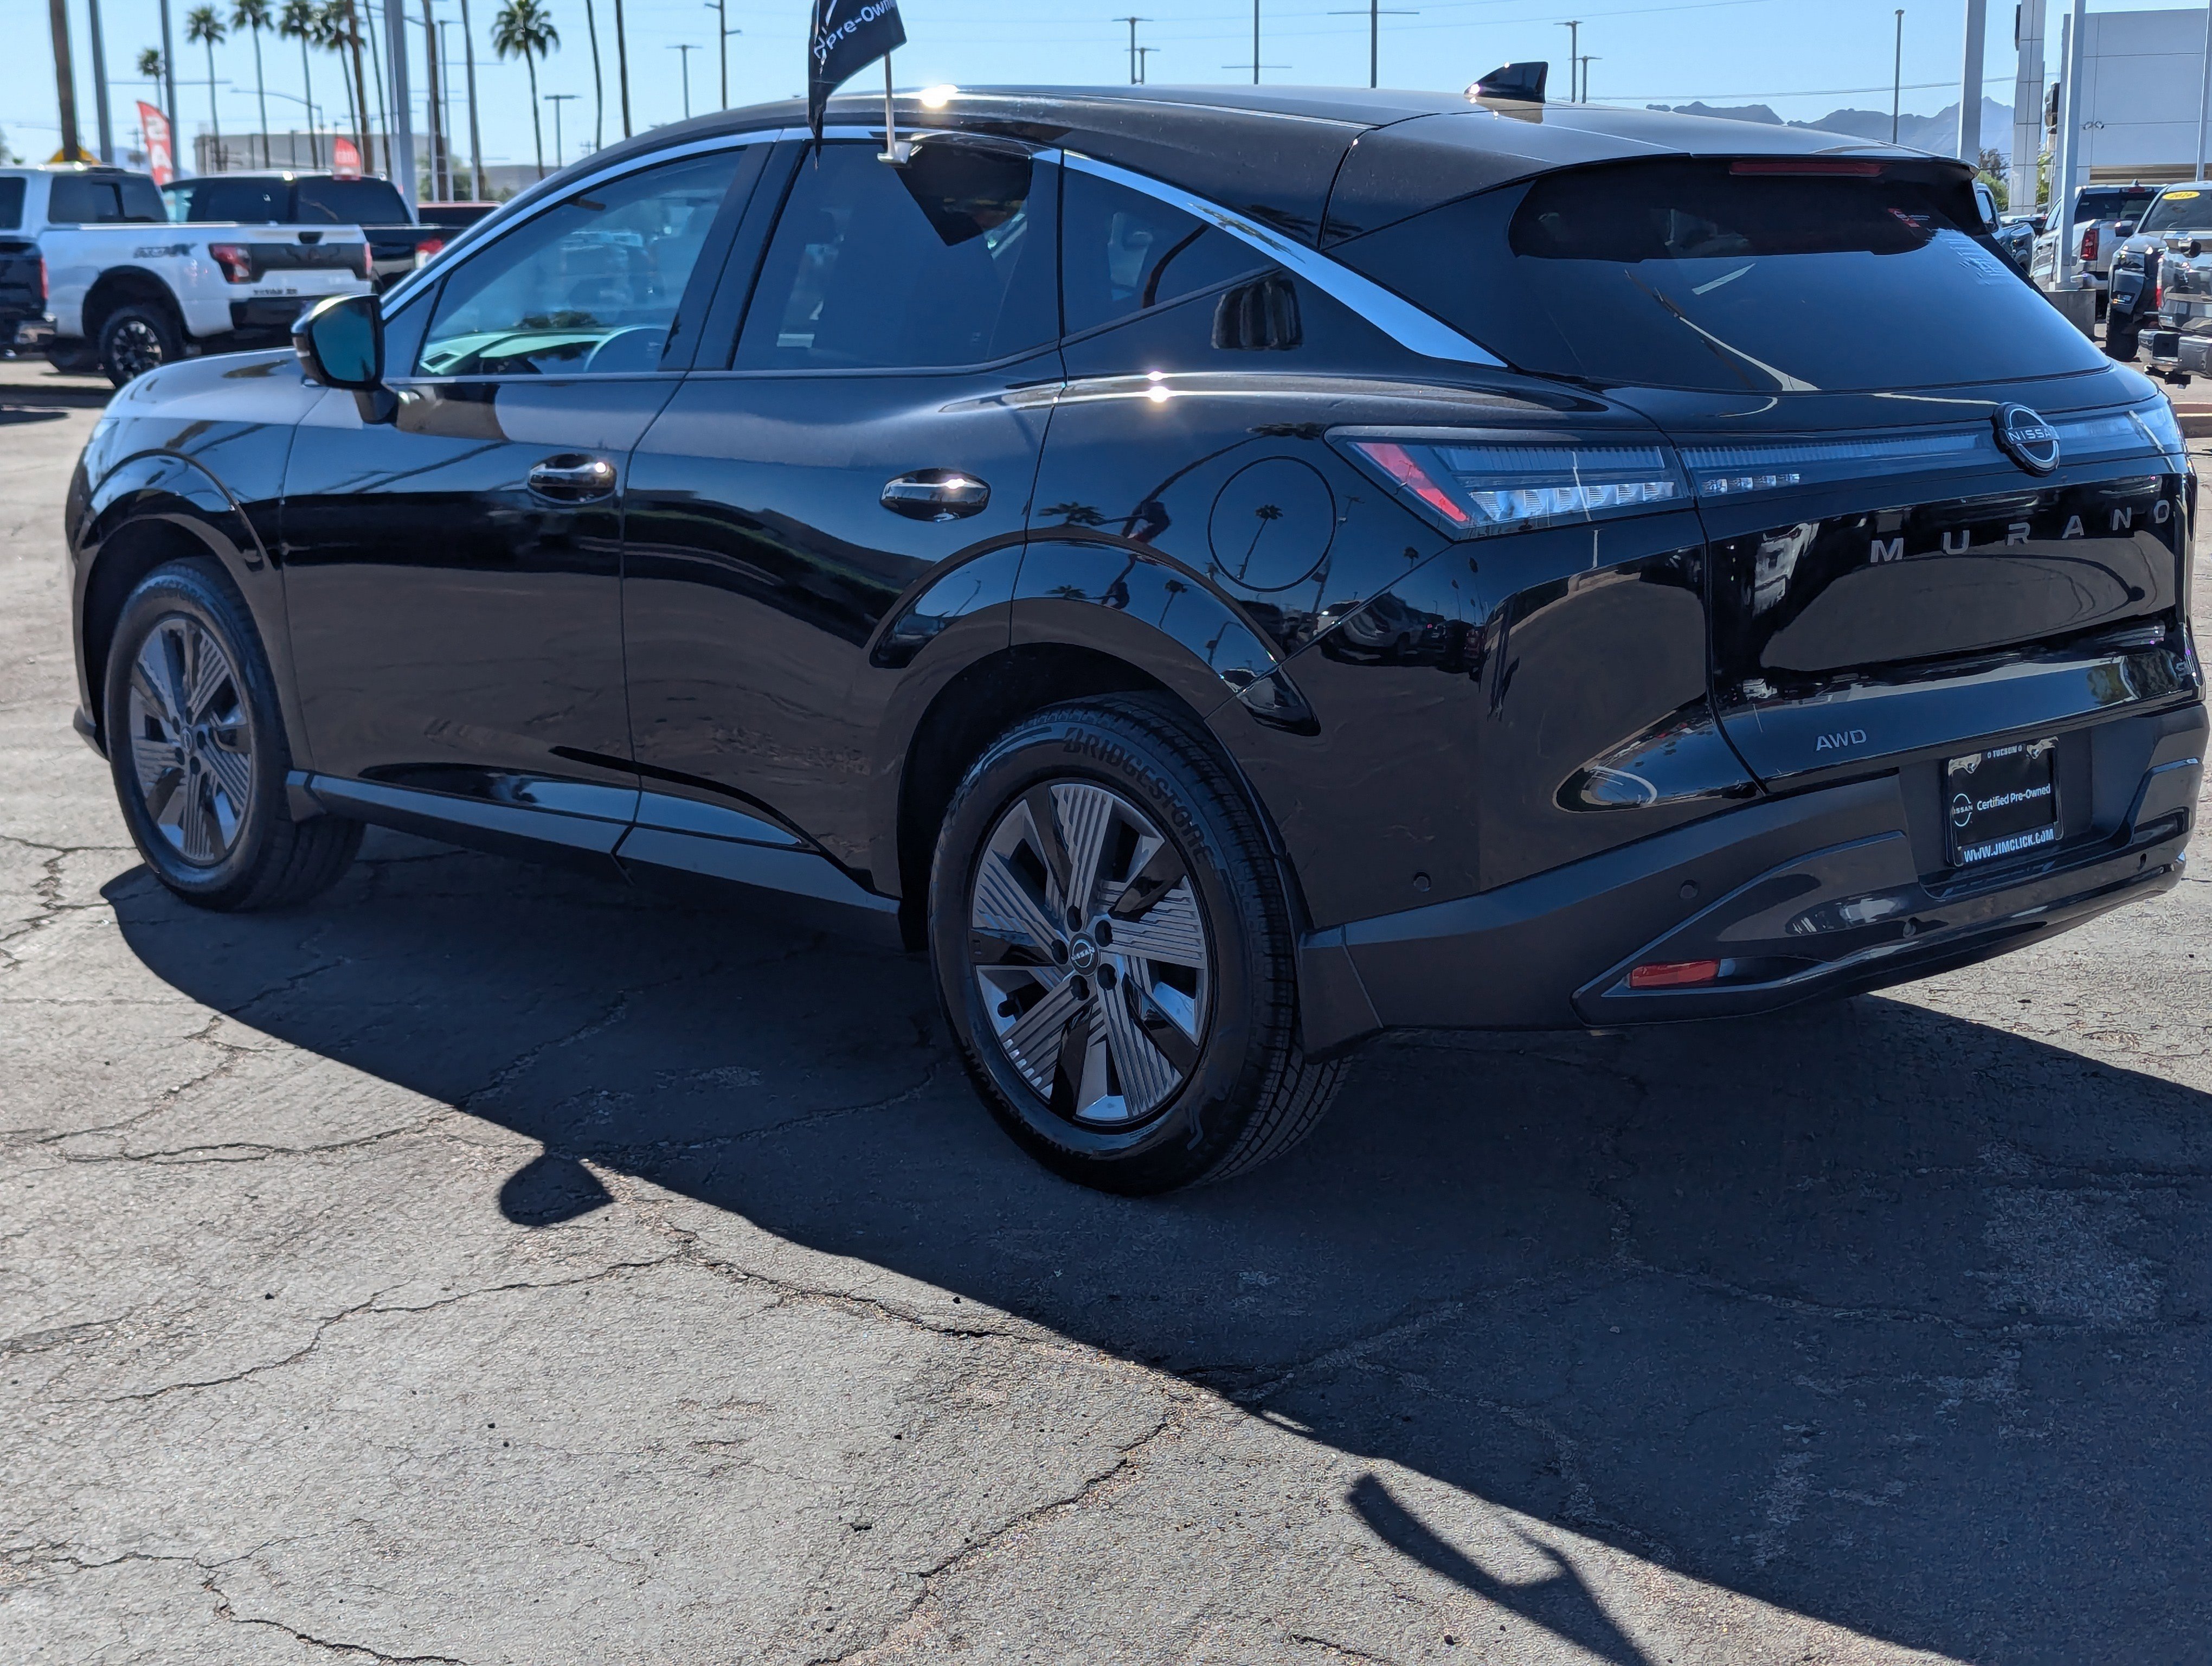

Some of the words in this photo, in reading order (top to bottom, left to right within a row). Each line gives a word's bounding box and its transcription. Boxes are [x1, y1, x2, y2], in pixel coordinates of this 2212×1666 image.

[1870, 500, 2169, 563] MURANO
[1816, 729, 1867, 751] AWD
[1063, 727, 1214, 864] BRIDGESTONE
[1977, 793, 2009, 811] Certified
[2010, 784, 2051, 803] Pre-Owned
[1964, 828, 2054, 863] WWW.JIMCLICK.COM
